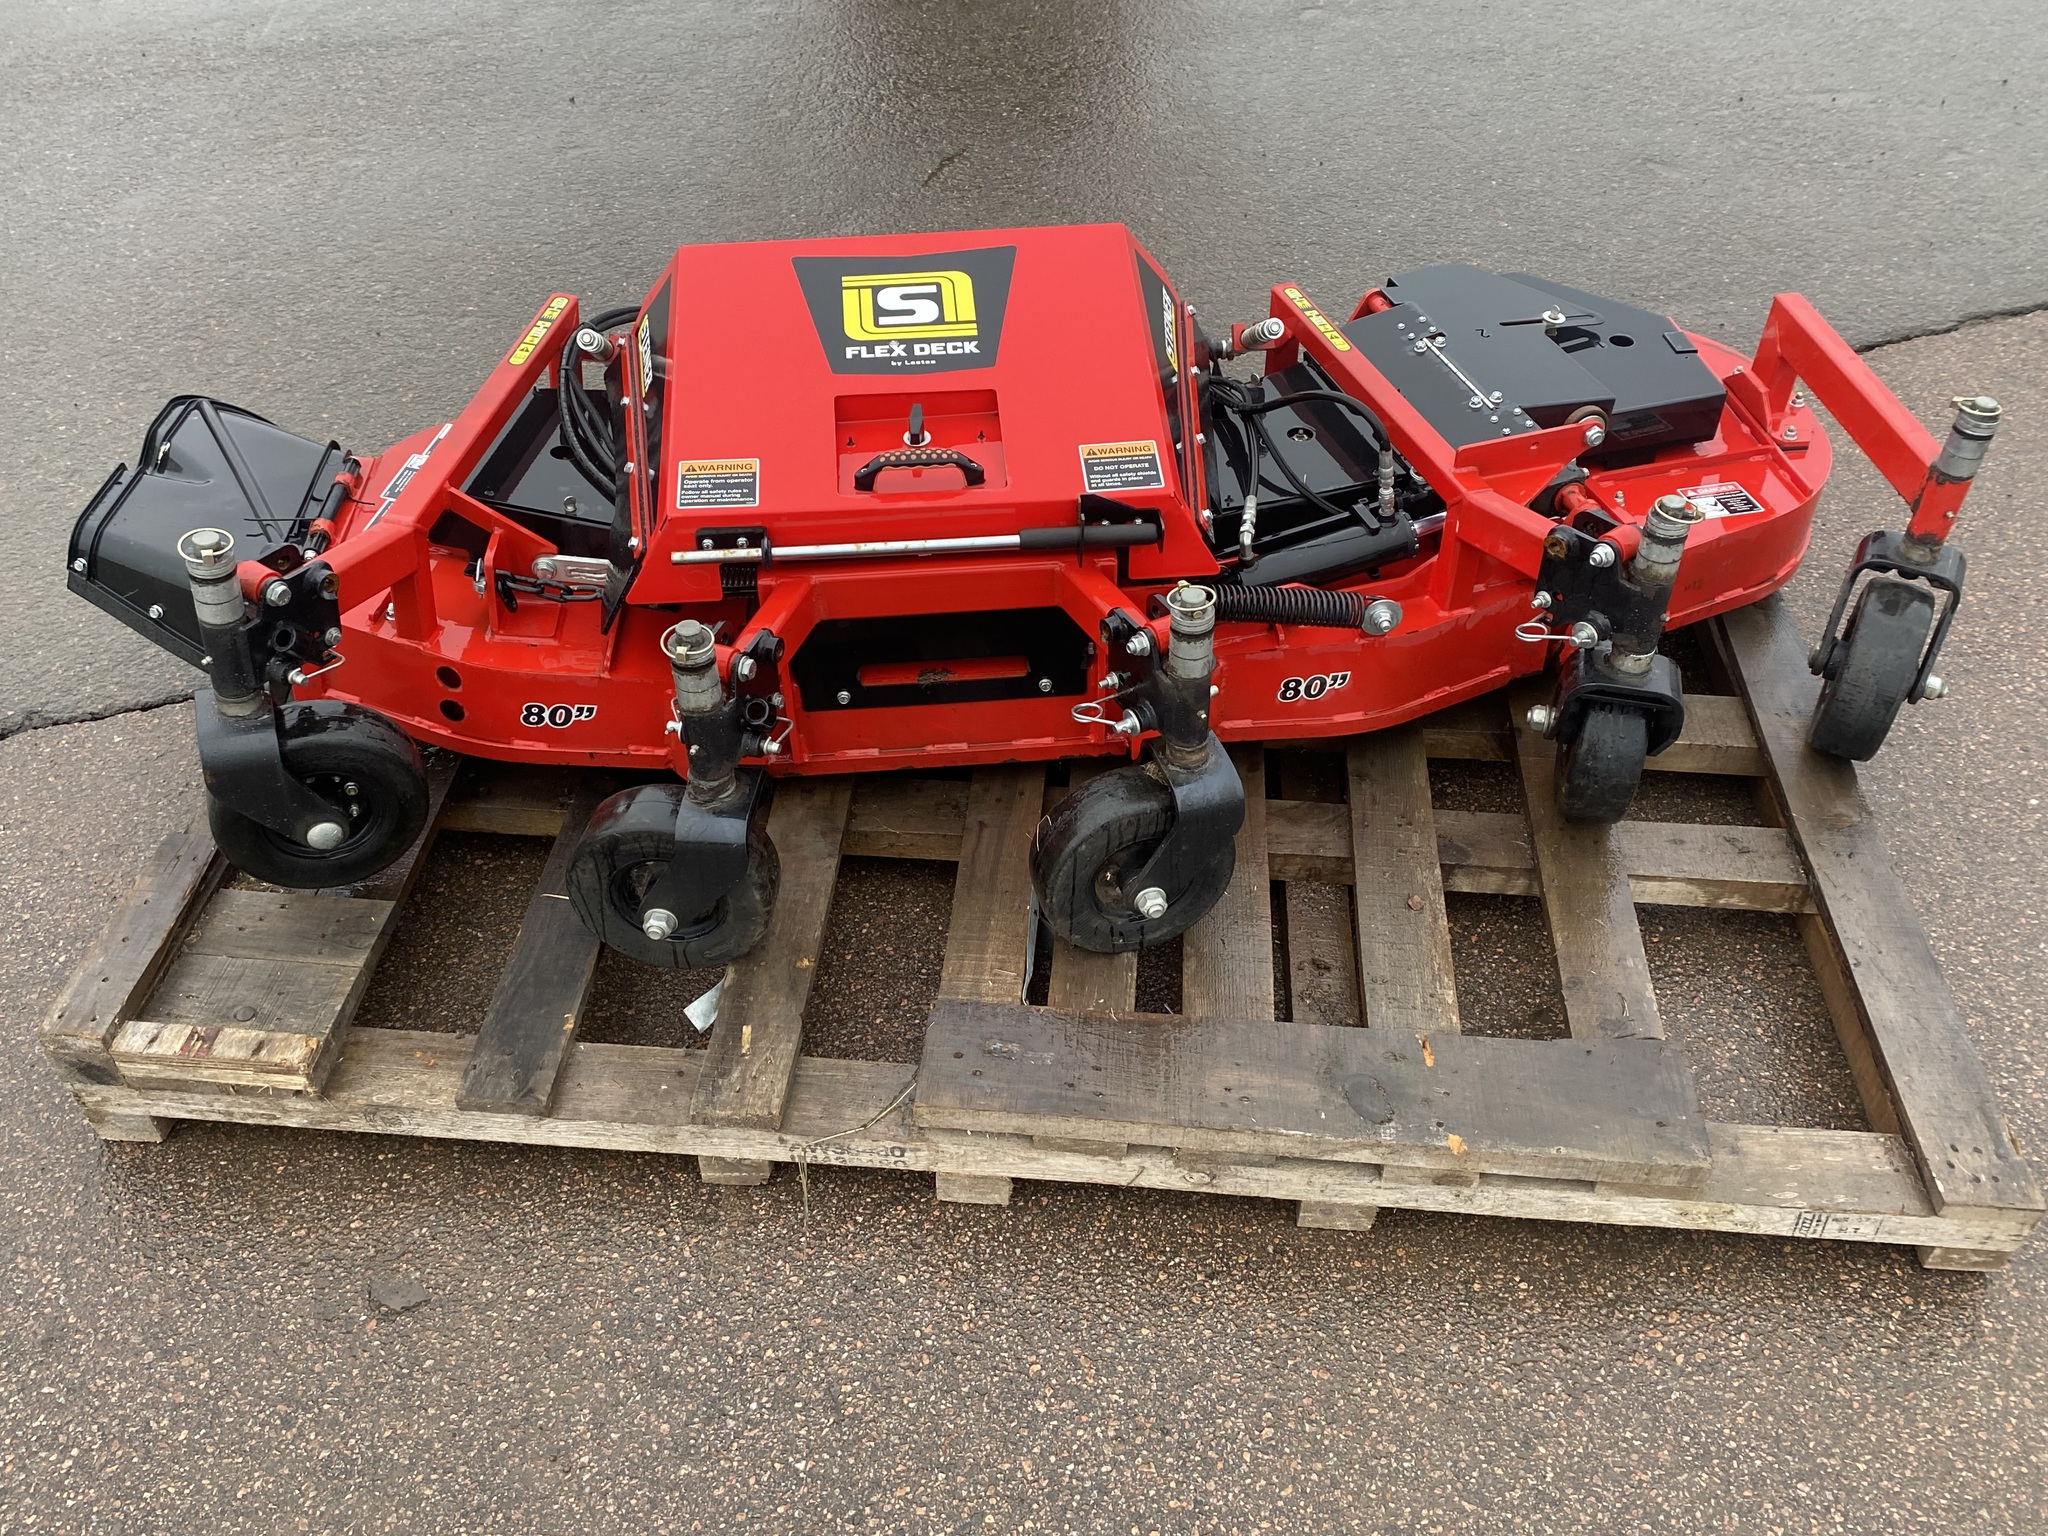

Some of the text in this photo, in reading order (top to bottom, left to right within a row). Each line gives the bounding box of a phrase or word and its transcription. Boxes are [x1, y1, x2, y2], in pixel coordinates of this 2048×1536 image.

[845, 340, 981, 359] FLEX DECK
[1097, 445, 1152, 455] WARNING
[697, 463, 753, 472] WARNING
[1119, 462, 1150, 470] OPERATE
[1696, 484, 1737, 494] DANGER
